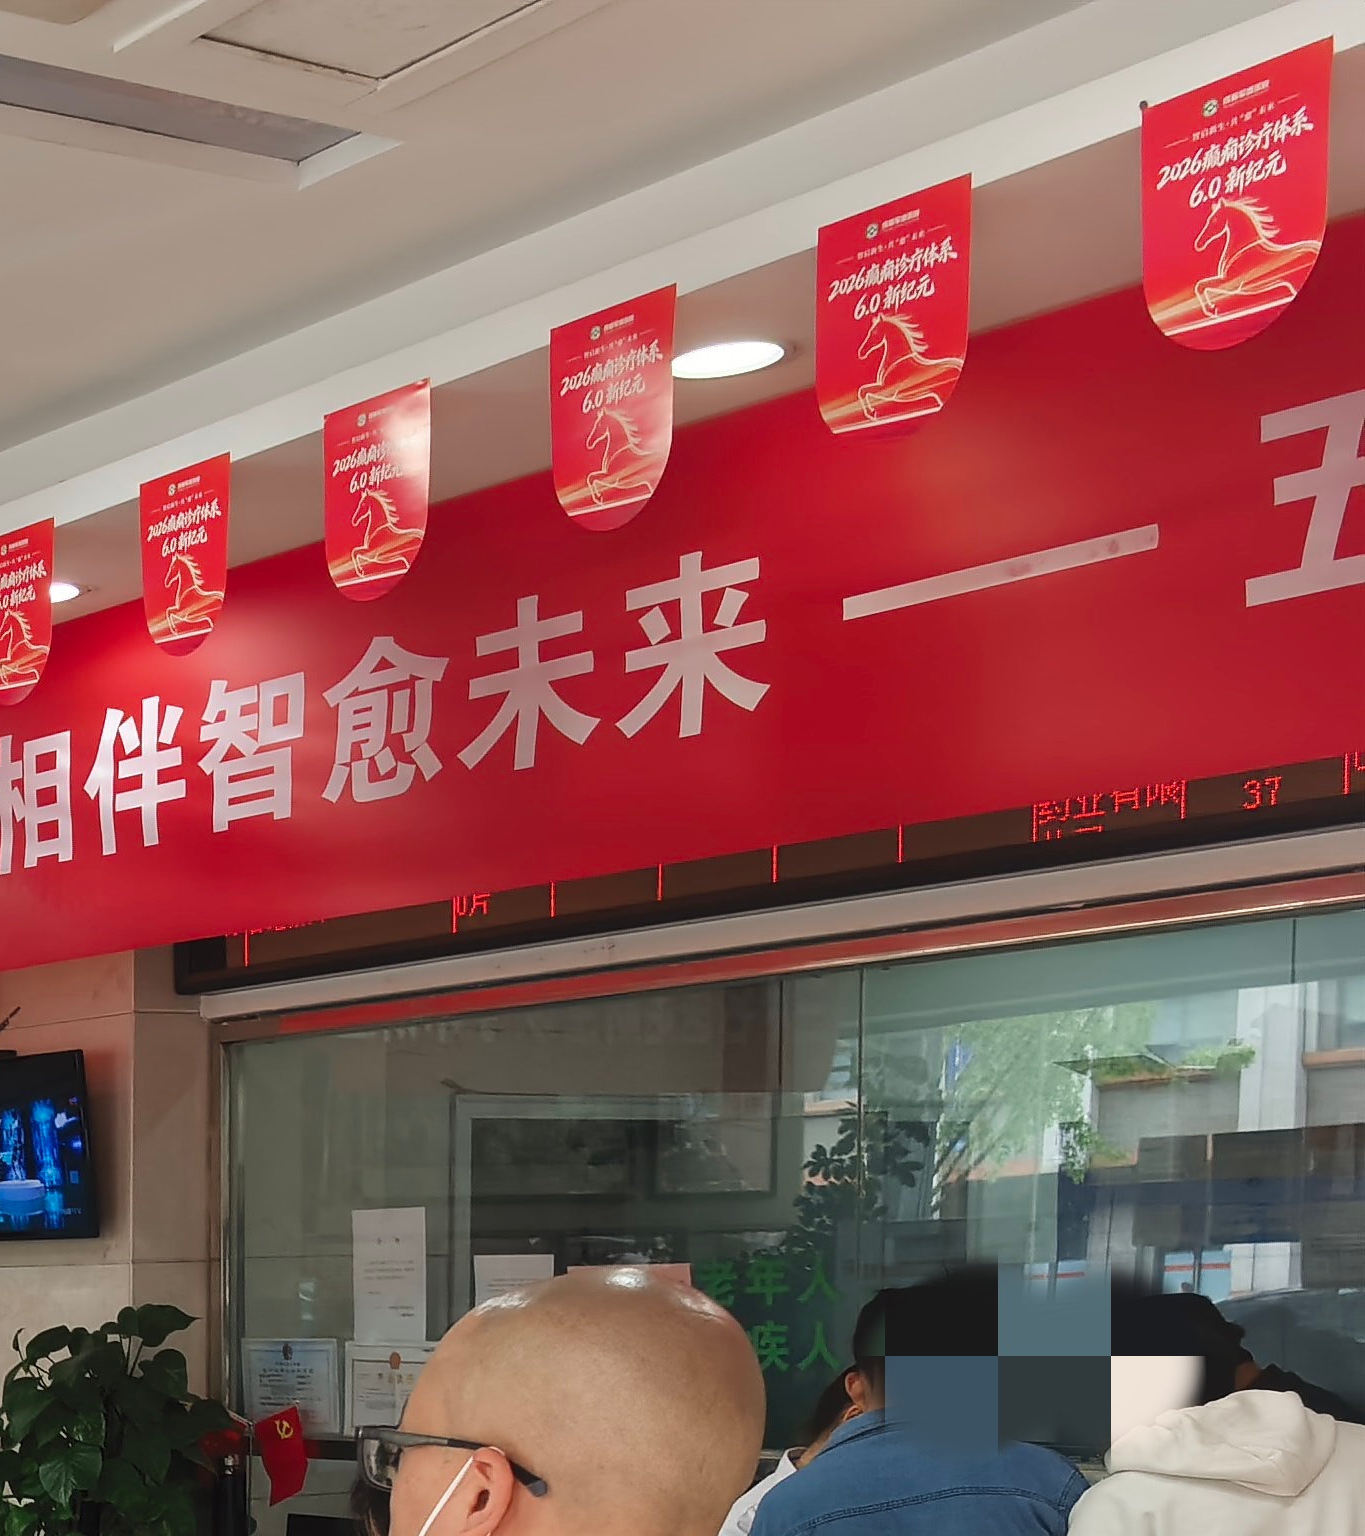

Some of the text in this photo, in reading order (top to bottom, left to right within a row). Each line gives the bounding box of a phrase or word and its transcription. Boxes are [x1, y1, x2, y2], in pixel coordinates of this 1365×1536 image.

[1156, 105, 1314, 190] 2026癫痫诊疗体系
[1188, 149, 1286, 208] 6.0 新纪元
[828, 236, 958, 303] 2026癫痫诊疗体系
[854, 273, 935, 321] 6.0 新纪元
[582, 372, 645, 413] 6.0 新纪元
[350, 468, 366, 494] 6.0
[161, 525, 208, 557] 6.0 新纪元
[1243, 776, 1283, 810] 37
[698, 1256, 845, 1308] 老年人
